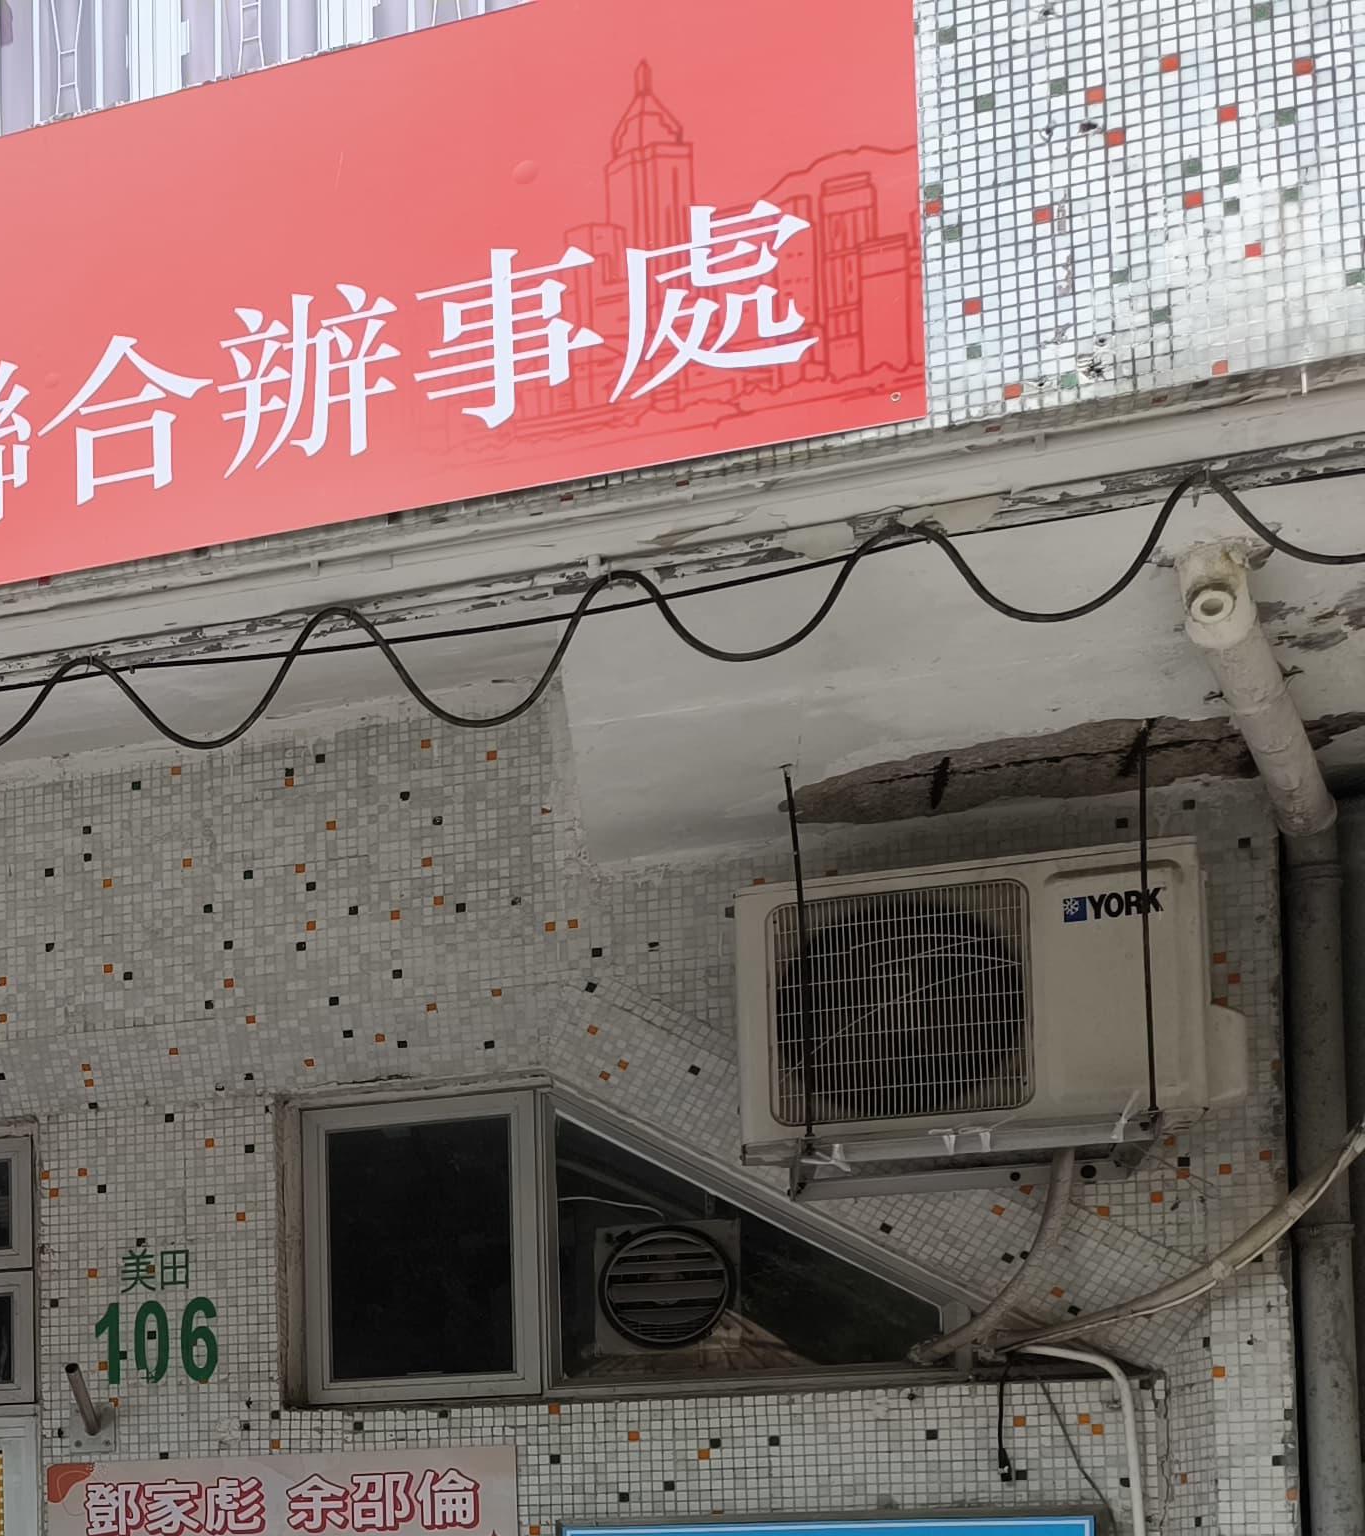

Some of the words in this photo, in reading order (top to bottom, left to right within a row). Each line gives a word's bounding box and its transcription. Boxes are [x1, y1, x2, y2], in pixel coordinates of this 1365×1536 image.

[1087, 886, 1165, 920] YORK
[121, 1249, 190, 1293] 美田
[94, 1297, 219, 1385] 106
[287, 1468, 481, 1532] 余邵倫
